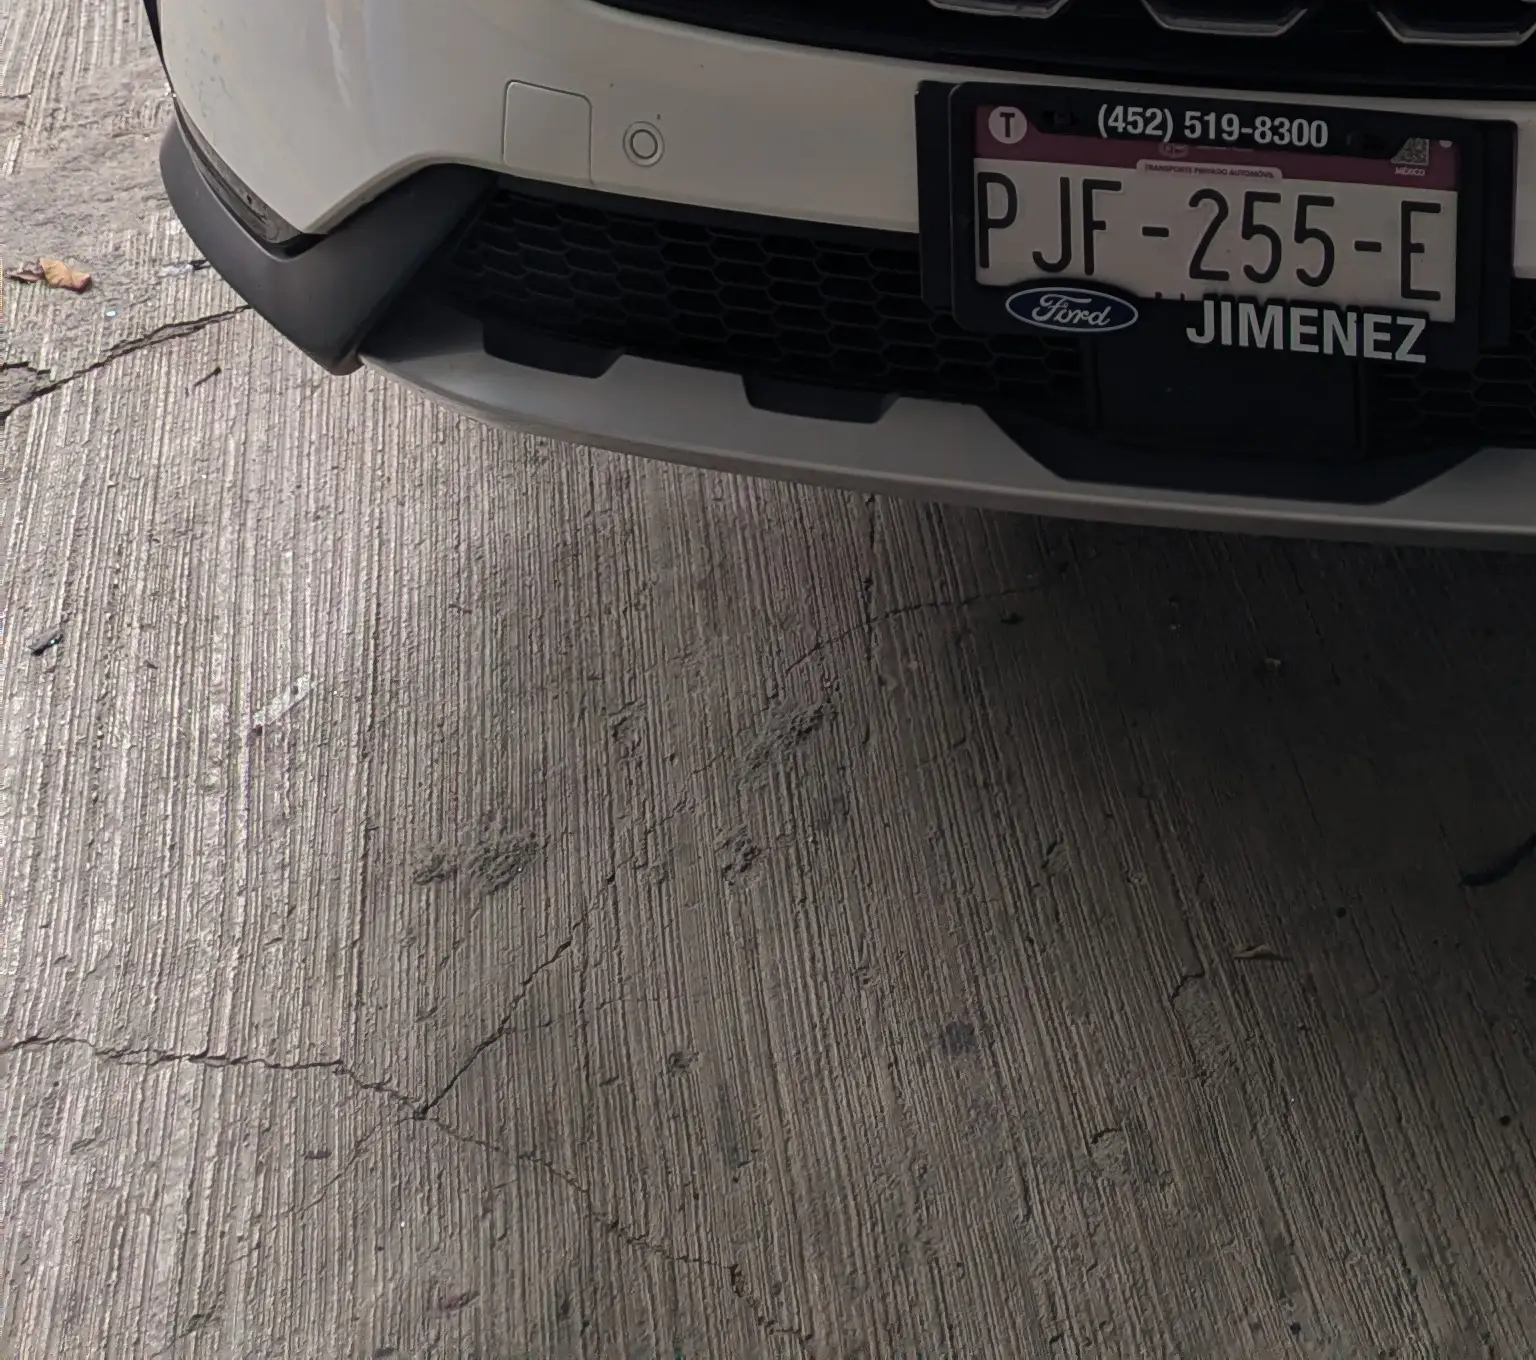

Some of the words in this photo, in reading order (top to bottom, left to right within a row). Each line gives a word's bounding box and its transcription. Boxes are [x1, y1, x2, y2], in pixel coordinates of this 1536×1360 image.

[999, 112, 1016, 138] T
[1097, 103, 1174, 143] (452)
[1183, 110, 1329, 148] 519-8300
[976, 171, 1442, 302] PJF-255-E
[1031, 293, 1111, 326] Ford
[1186, 299, 1428, 364] JIMENEZ
